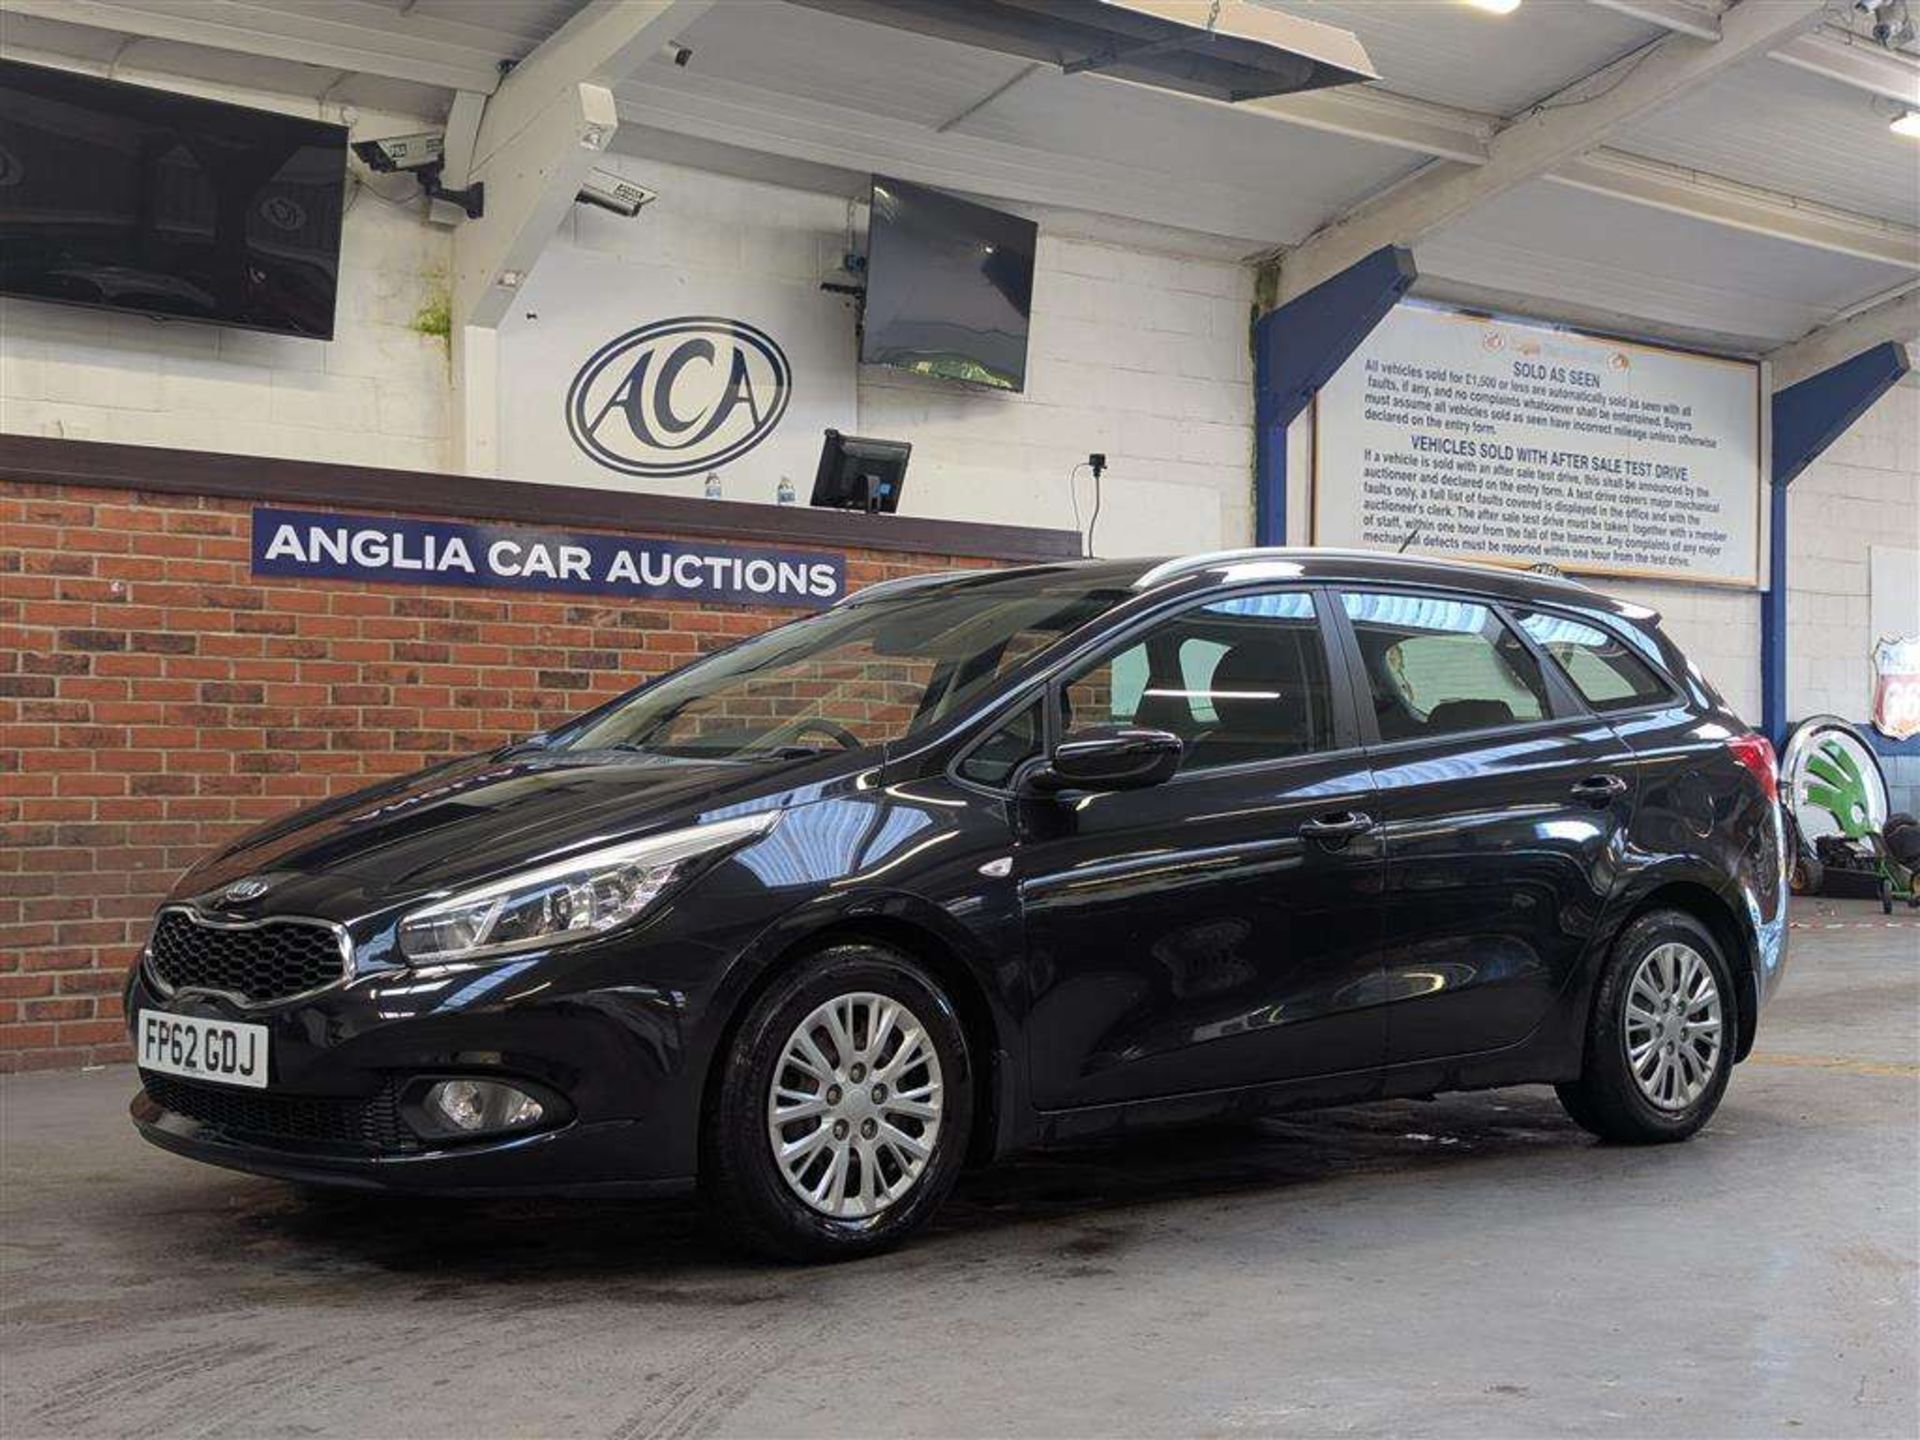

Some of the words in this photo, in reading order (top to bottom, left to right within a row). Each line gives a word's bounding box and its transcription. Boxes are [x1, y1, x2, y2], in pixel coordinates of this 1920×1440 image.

[587, 338, 761, 449] ACA
[1365, 359, 1378, 371] All
[1380, 363, 1422, 377] vehicles
[1425, 369, 1446, 380] sold
[1450, 371, 1462, 383] for
[1498, 381, 1508, 389] or
[1532, 386, 1546, 395] are
[1608, 395, 1627, 406] sold
[1630, 400, 1639, 408] as
[1642, 401, 1661, 411] seen
[1663, 402, 1680, 414] with
[1682, 405, 1691, 416] all
[1514, 362, 1546, 379] SOLD
[1550, 367, 1566, 382] AS
[1568, 370, 1600, 387] SEEN
[1365, 394, 1390, 404] must
[1392, 397, 1431, 410] assume
[1435, 402, 1446, 412] all
[1448, 404, 1488, 417] vehicles
[1490, 410, 1510, 420] sold
[1513, 414, 1523, 422] as
[1526, 415, 1547, 425] seen
[1550, 417, 1571, 429] have
[1573, 419, 1612, 434] incorrect
[1614, 426, 1647, 441] mileage
[1650, 431, 1676, 443] unless
[1678, 434, 1716, 448] otherwise
[1365, 408, 1408, 423] declared
[1412, 416, 1423, 425] on
[1426, 416, 1441, 427] the
[1445, 420, 1469, 434] entry
[1402, 380, 1408, 391] if
[1434, 386, 1452, 397] and
[1455, 390, 1467, 399] no
[1470, 392, 1520, 406] complaints
[1524, 398, 1573, 414] whatsoever
[1577, 405, 1596, 417] shall
[1599, 407, 1609, 419] be
[1664, 416, 1691, 431] Buyers
[1365, 450, 1371, 460] If
[1383, 453, 1418, 465] vehicle
[1421, 456, 1429, 466] is
[1433, 458, 1453, 469] sold
[1456, 461, 1476, 471] with
[1480, 464, 1490, 473] an
[1494, 464, 1513, 475] after
[1517, 467, 1534, 478] sale
[1538, 469, 1554, 480] test
[1584, 474, 1600, 485] this
[1603, 477, 1624, 488] shall
[1626, 478, 1636, 489] be
[1638, 482, 1682, 494] announced
[1685, 485, 1693, 498] by
[1696, 486, 1708, 497] the
[1411, 435, 1476, 455] VEHICLES
[1480, 443, 1513, 460] SOLD
[1517, 448, 1547, 464] WITH
[1550, 452, 1588, 469] AFTER
[1591, 457, 1621, 473] SALE
[1625, 461, 1652, 477] TEST
[1655, 464, 1688, 481] DRIVE
[1364, 468, 1416, 481] auctioneer
[1419, 474, 1438, 483] and
[1440, 474, 1482, 487] declared
[1485, 480, 1496, 489] on
[1500, 480, 1513, 490] the
[1516, 483, 1539, 496] entry
[1576, 488, 1593, 498] test
[1595, 490, 1616, 501] drive
[1619, 494, 1647, 504] covers
[1650, 496, 1672, 508] major
[1674, 499, 1720, 511] mechanical
[1364, 482, 1391, 494] faults
[1430, 488, 1446, 500] full
[1448, 490, 1462, 501] list
[1465, 492, 1474, 502] of
[1477, 493, 1502, 505] faults
[1506, 498, 1542, 509] covered
[1544, 500, 1551, 510] is
[1554, 501, 1597, 517] displayed
[1600, 505, 1606, 515] in
[1610, 506, 1623, 517] the
[1626, 508, 1648, 520] office
[1652, 511, 1667, 521] and
[1669, 513, 1686, 523] with
[1688, 514, 1700, 525] the
[1363, 515, 1373, 524] of
[1406, 519, 1434, 530] within
[1437, 523, 1455, 531] one
[1458, 523, 1479, 534] hour
[1482, 525, 1504, 536] from
[1506, 527, 1520, 537] the
[1523, 528, 1537, 539] fall
[1539, 530, 1548, 540] of
[1550, 531, 1564, 541] the
[1606, 536, 1622, 549] Any
[1625, 539, 1670, 551] complaints
[1672, 542, 1680, 551] of
[1683, 544, 1697, 555] any
[1698, 545, 1721, 557] major
[1458, 508, 1475, 518] The
[1478, 510, 1499, 520] after
[1502, 512, 1520, 522] sale
[1522, 513, 1540, 524] test
[1542, 515, 1564, 526] drive
[1567, 519, 1588, 528] must
[1591, 520, 1602, 529] be
[1632, 523, 1667, 536] together
[1669, 527, 1686, 537] with
[1695, 531, 1726, 541] member
[265, 524, 475, 573] ANGLIA
[487, 541, 592, 580] CAR
[606, 550, 838, 597] AUCTIONS
[1363, 532, 1420, 544] mechanial
[1423, 535, 1458, 547] defects
[1462, 540, 1485, 549] must
[1488, 540, 1500, 550] be
[1502, 543, 1541, 554] reported
[1543, 545, 1569, 556] within
[1572, 549, 1588, 557] one
[1591, 548, 1610, 559] hour
[1612, 550, 1633, 561] from
[1635, 552, 1648, 562] the
[1650, 553, 1667, 564] test
[145, 1017, 198, 1068] FP62
[204, 1027, 256, 1077] GDJ
